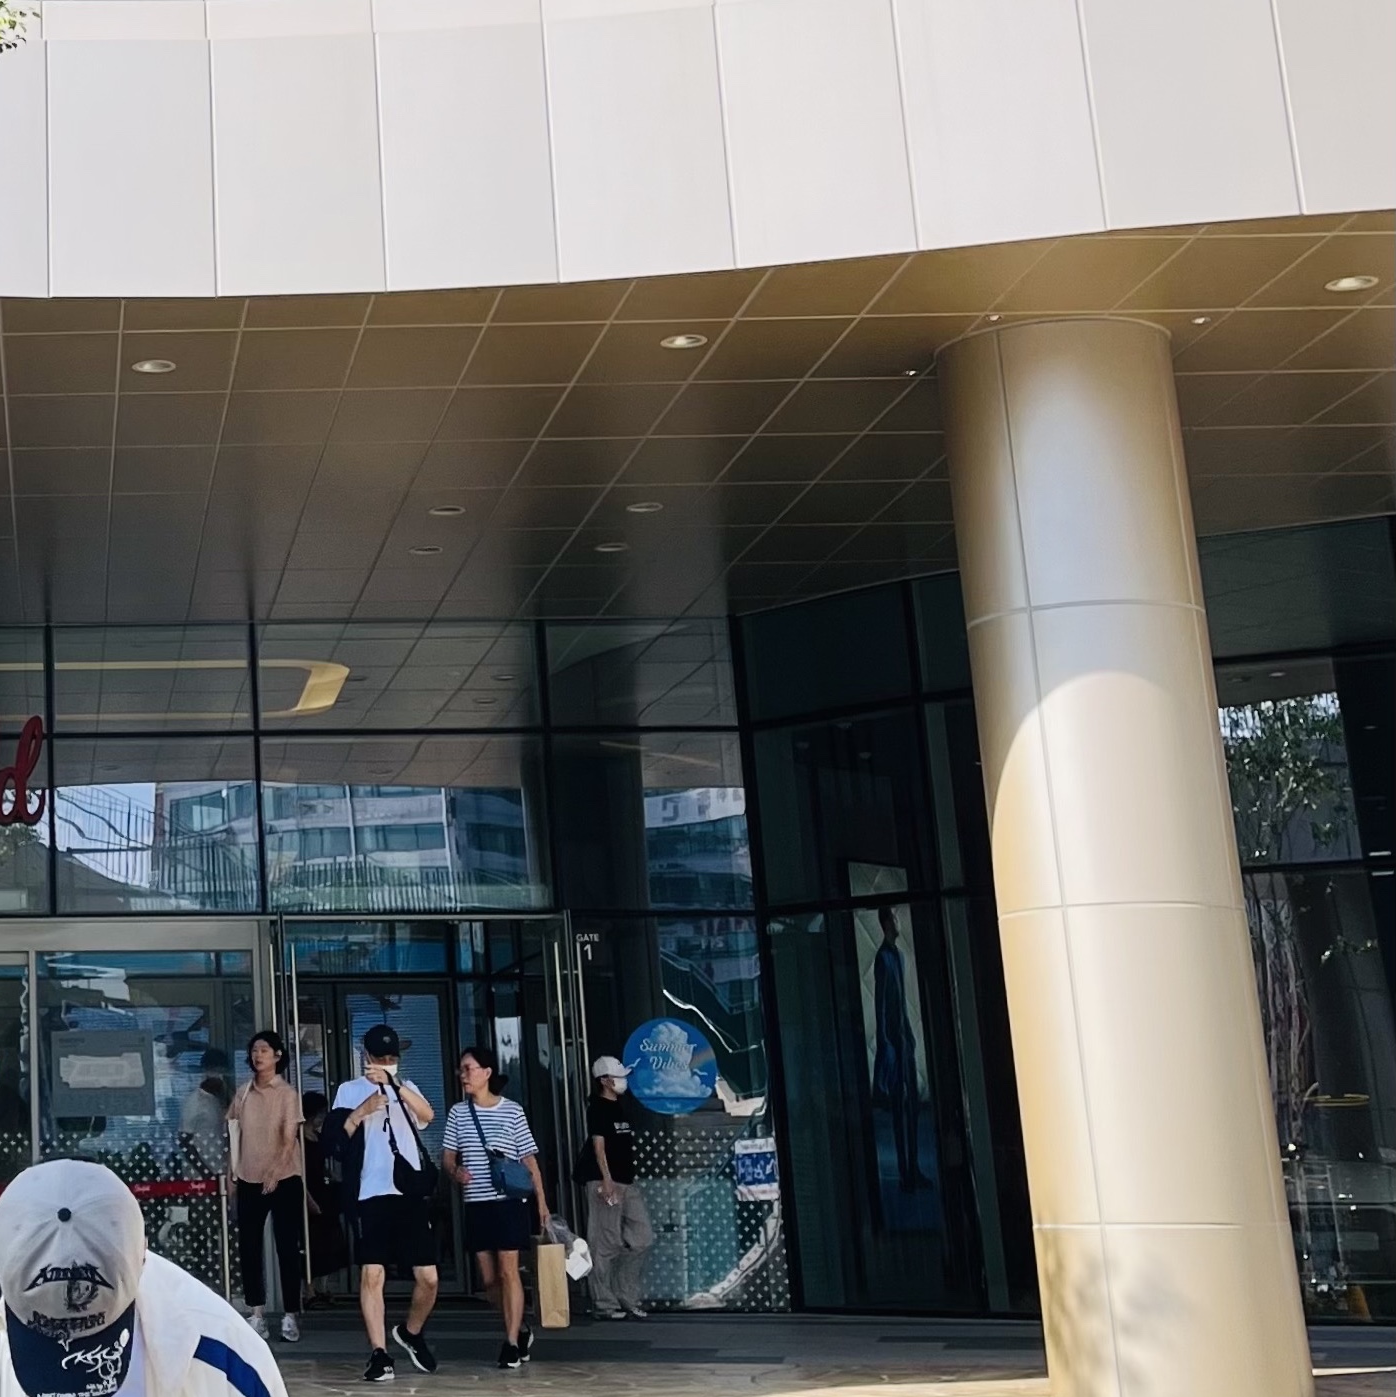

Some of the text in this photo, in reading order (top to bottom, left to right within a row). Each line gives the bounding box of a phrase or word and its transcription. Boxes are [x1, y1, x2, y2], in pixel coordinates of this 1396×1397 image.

[576, 933, 599, 942] GATE
[584, 943, 592, 961] 1
[640, 1039, 697, 1052] Summer
[650, 1056, 689, 1071] Vibes
